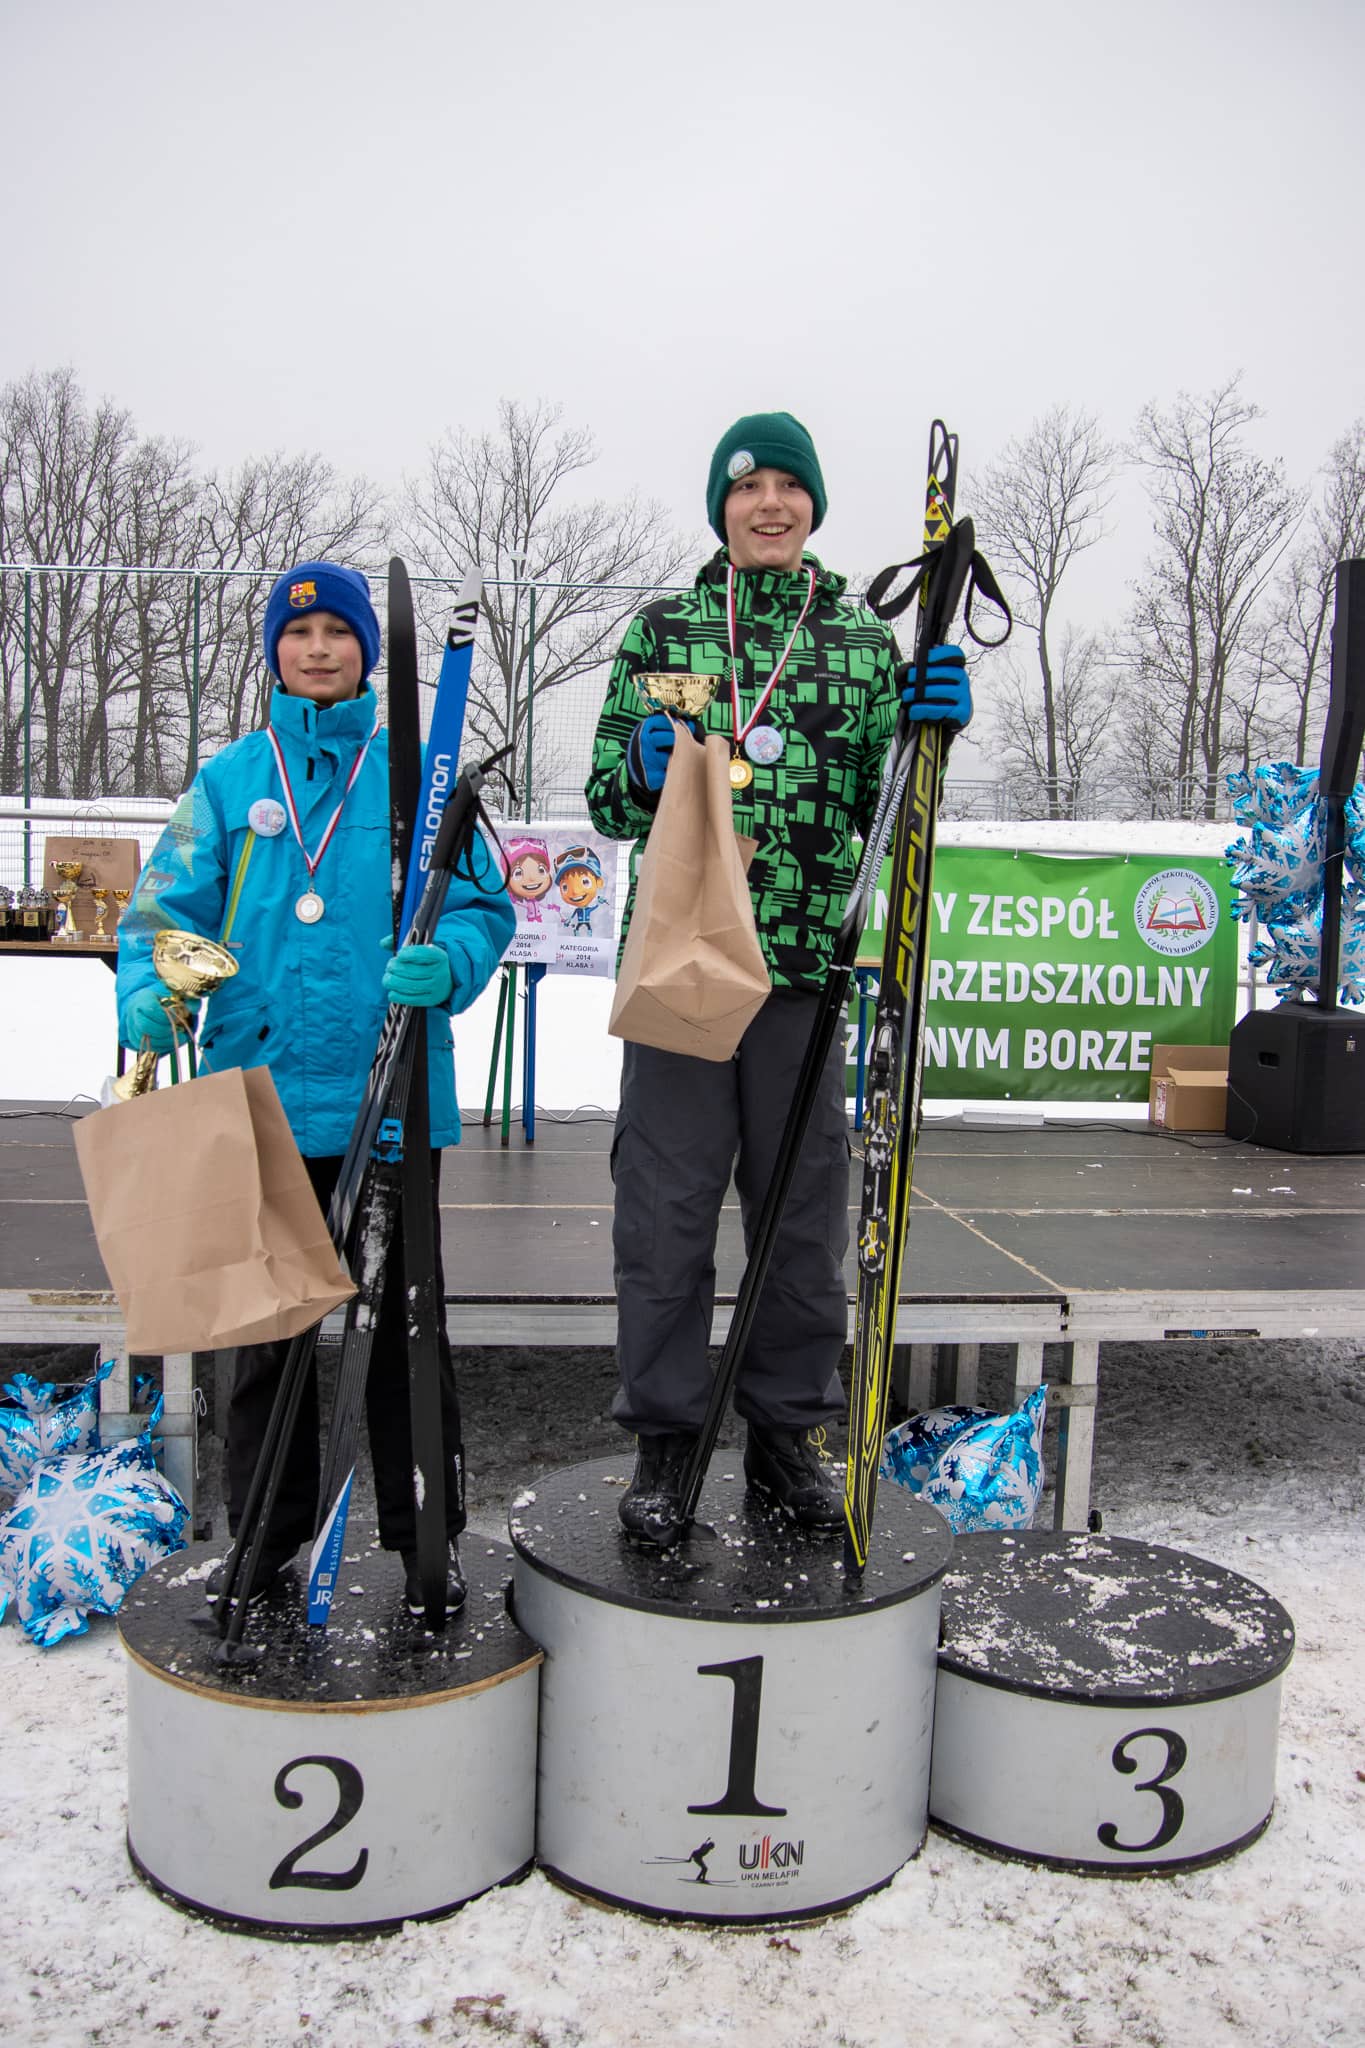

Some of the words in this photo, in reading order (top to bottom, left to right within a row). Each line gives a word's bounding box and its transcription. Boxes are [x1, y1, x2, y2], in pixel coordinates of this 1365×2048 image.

[966, 887, 1119, 939] ZESPÓŁ
[560, 944, 599, 952] KATEGORIA
[928, 959, 1210, 1007] RZEDSZKOLNY
[1023, 1028, 1152, 1071] BORZE
[311, 1590, 333, 1606] JR
[686, 1655, 788, 1817] 1
[1097, 1727, 1188, 1853] 3
[269, 1755, 369, 1891] 2
[741, 1873, 760, 1881] UKN
[762, 1870, 800, 1880] MELAFIR
